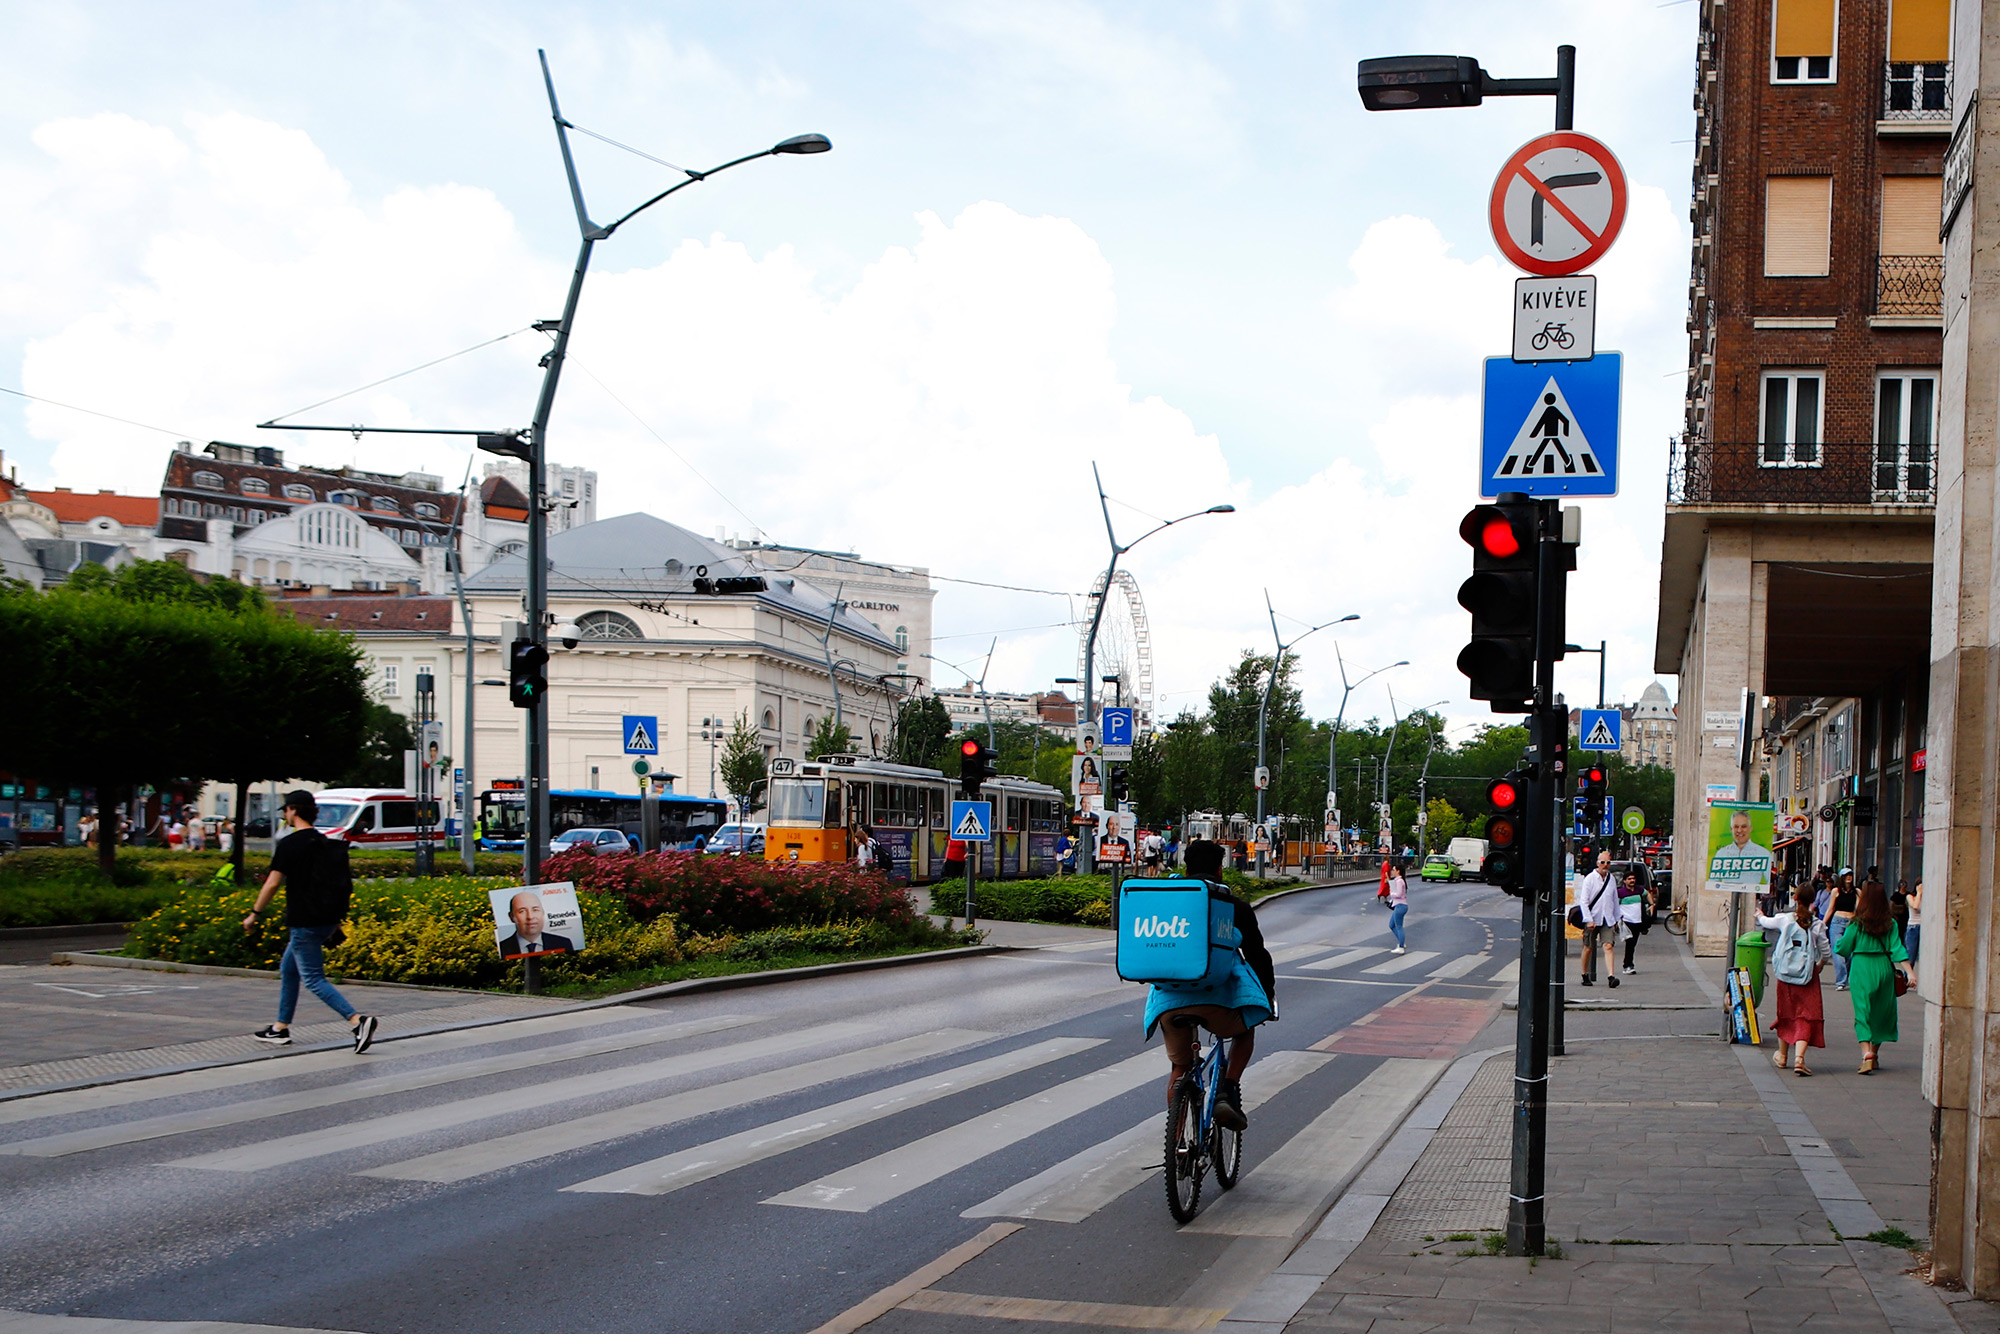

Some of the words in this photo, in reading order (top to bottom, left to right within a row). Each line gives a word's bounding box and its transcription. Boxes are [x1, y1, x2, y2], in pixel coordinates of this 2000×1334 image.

[1522, 286, 1588, 310] KIVÉVE
[851, 600, 900, 612] CARLTON
[1111, 717, 1125, 734] P
[775, 761, 790, 772] 47
[640, 778, 647, 787] E
[1711, 858, 1768, 871] BEREGI
[1710, 871, 1740, 879] BALÁZS
[547, 909, 577, 921] Benedek
[549, 919, 567, 928] Zsolt
[1134, 915, 1191, 939] Wolt
